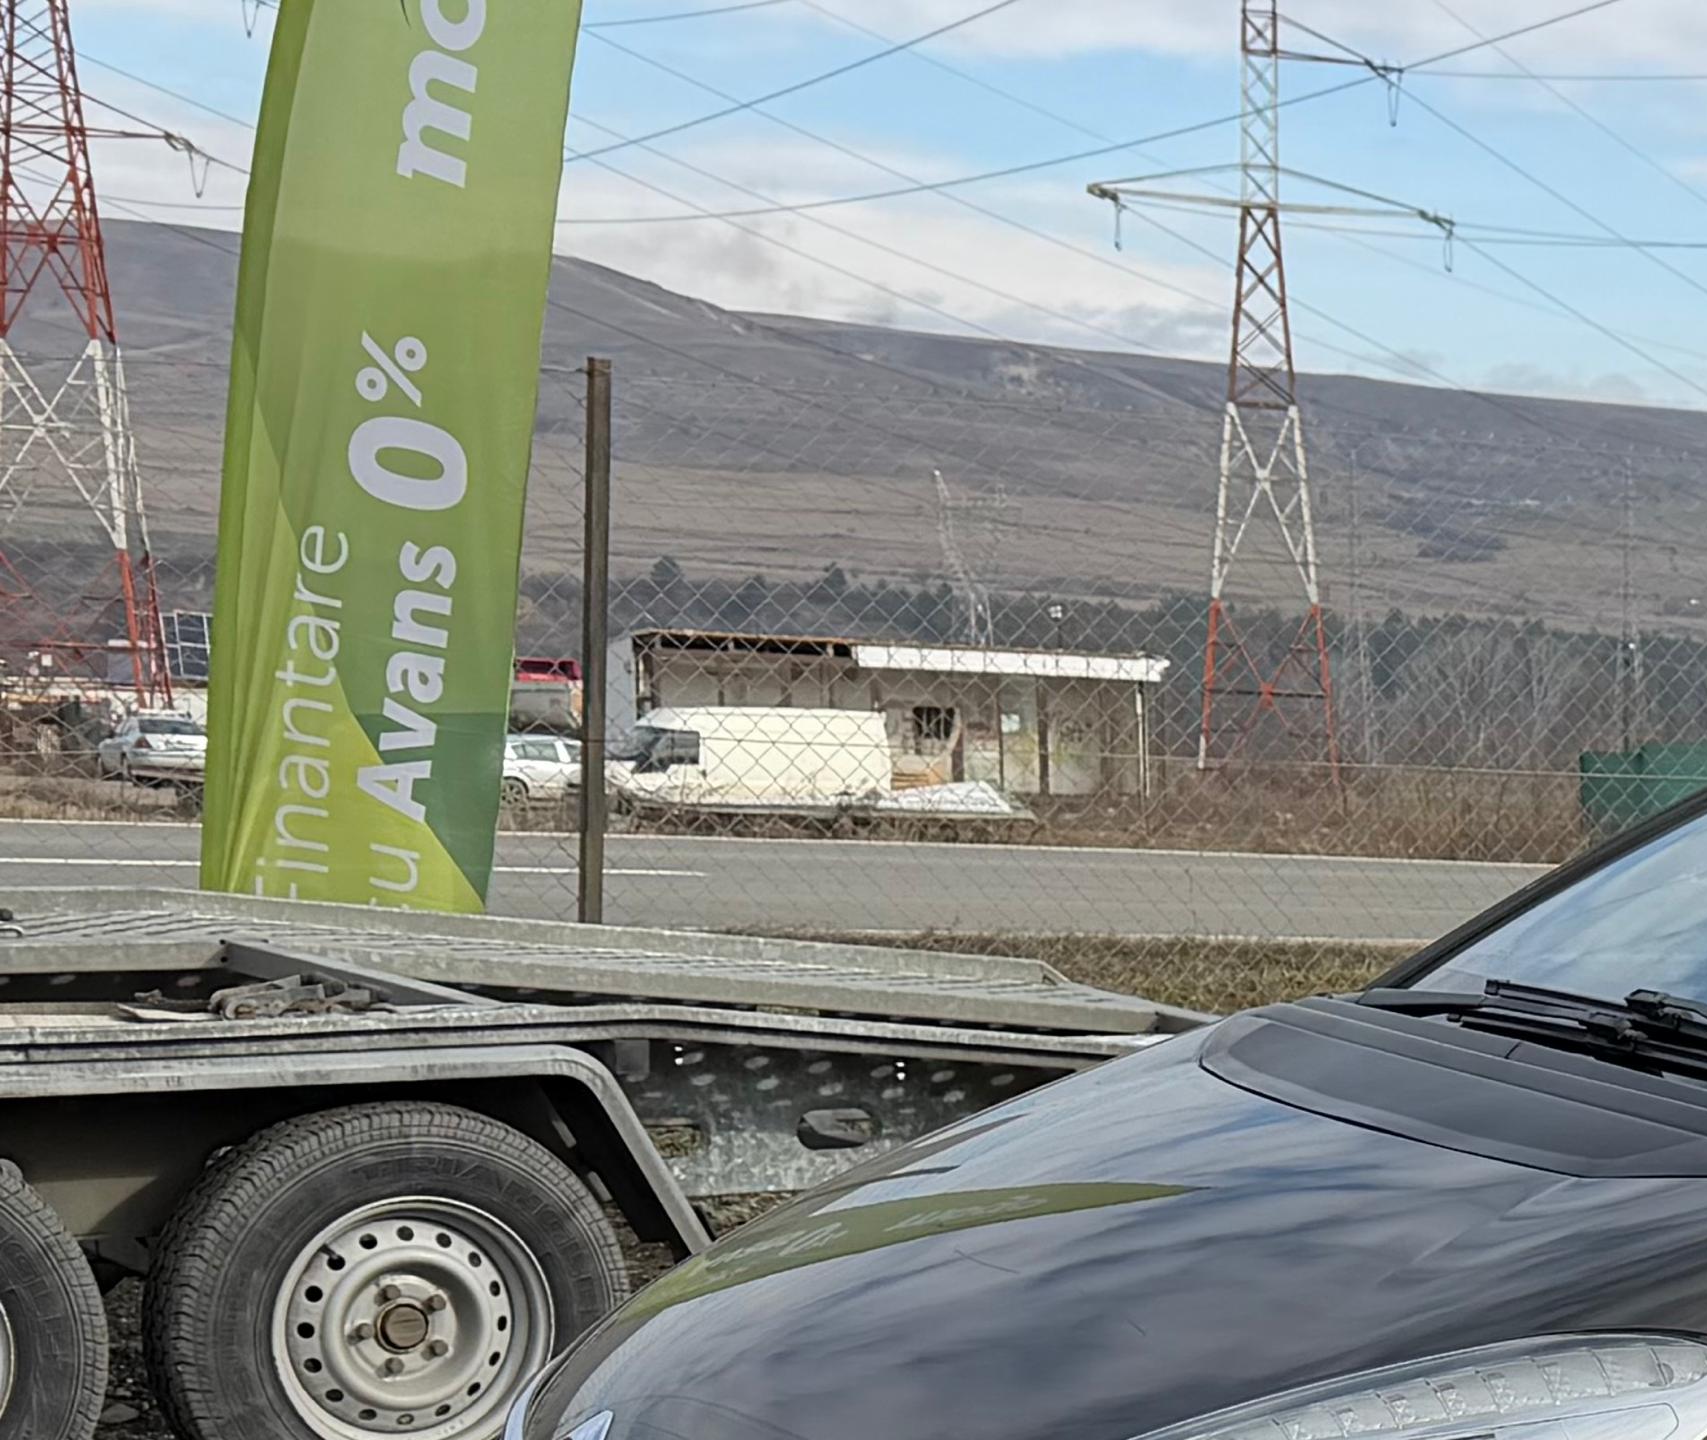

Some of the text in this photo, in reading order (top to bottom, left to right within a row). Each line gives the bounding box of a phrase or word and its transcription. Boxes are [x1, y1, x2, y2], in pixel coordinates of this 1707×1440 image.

[348, 331, 469, 909] u Avans 0%
